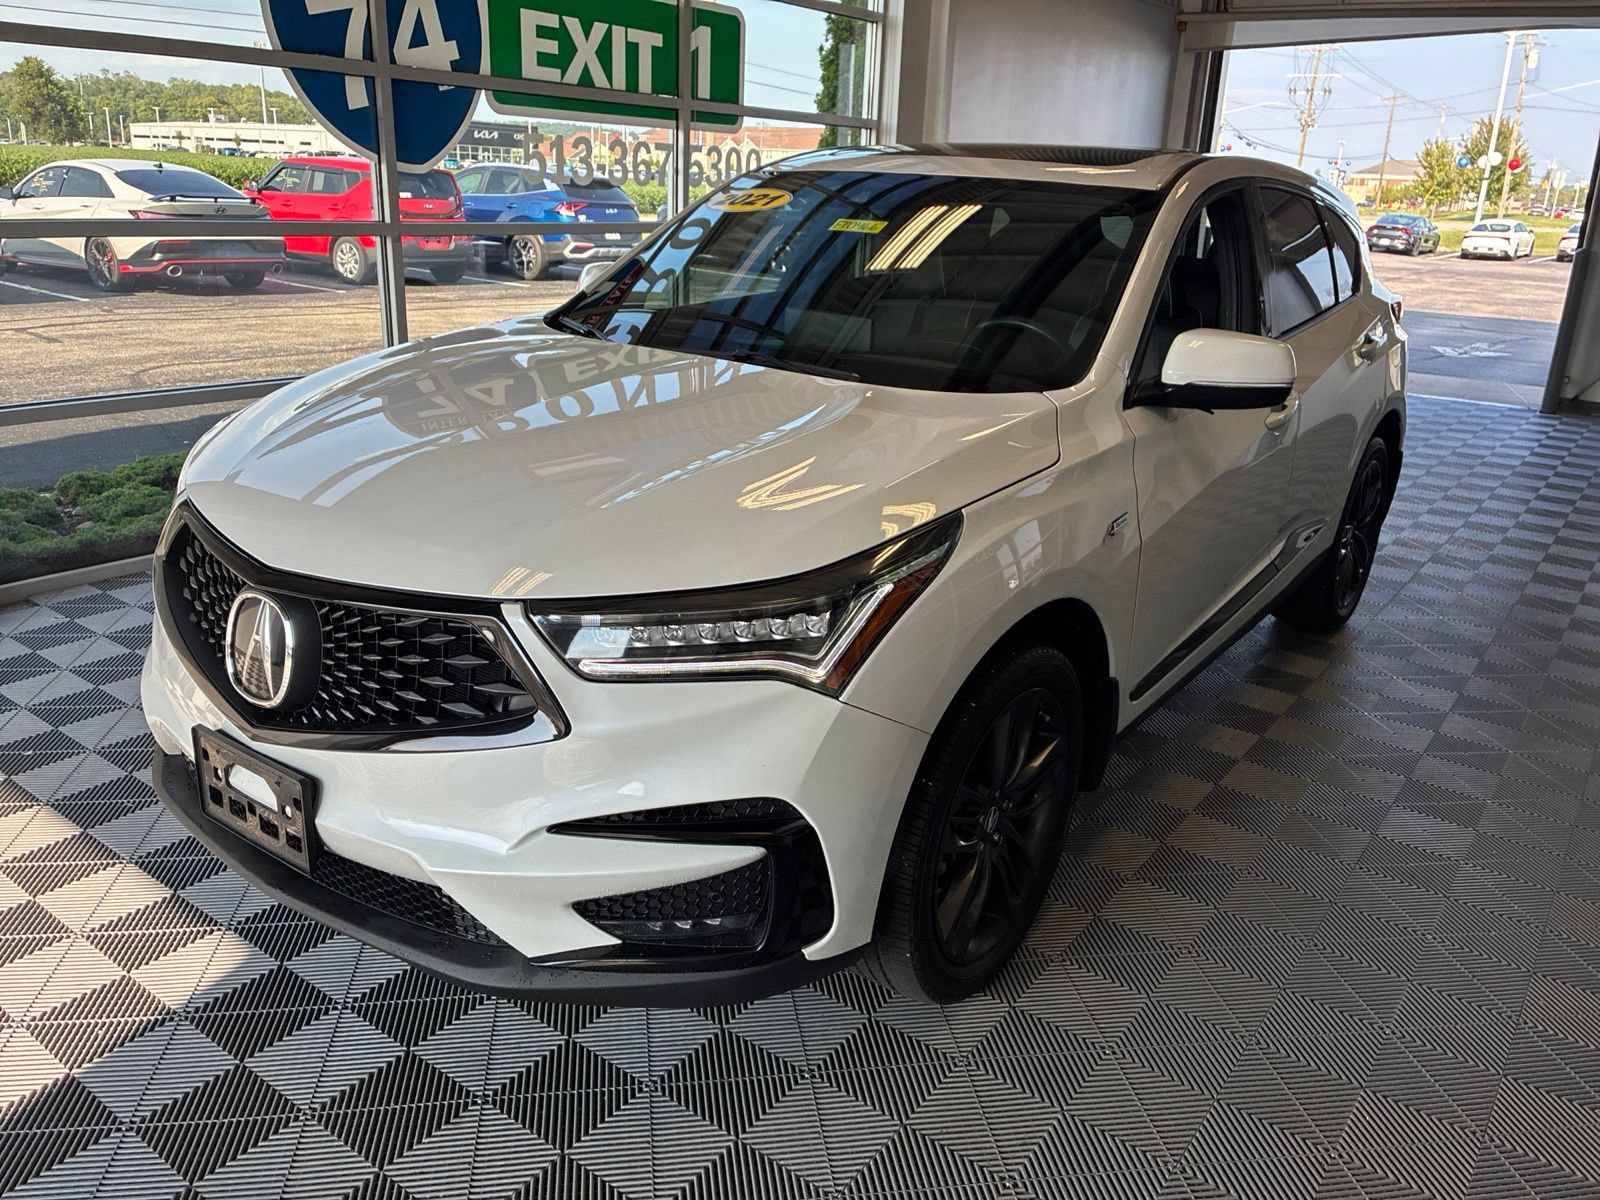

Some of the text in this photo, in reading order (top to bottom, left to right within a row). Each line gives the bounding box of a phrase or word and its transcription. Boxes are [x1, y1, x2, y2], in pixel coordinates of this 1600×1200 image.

[305, 0, 460, 110] 74
[519, 7, 711, 99] EXIT 1
[711, 192, 786, 206] 2021
